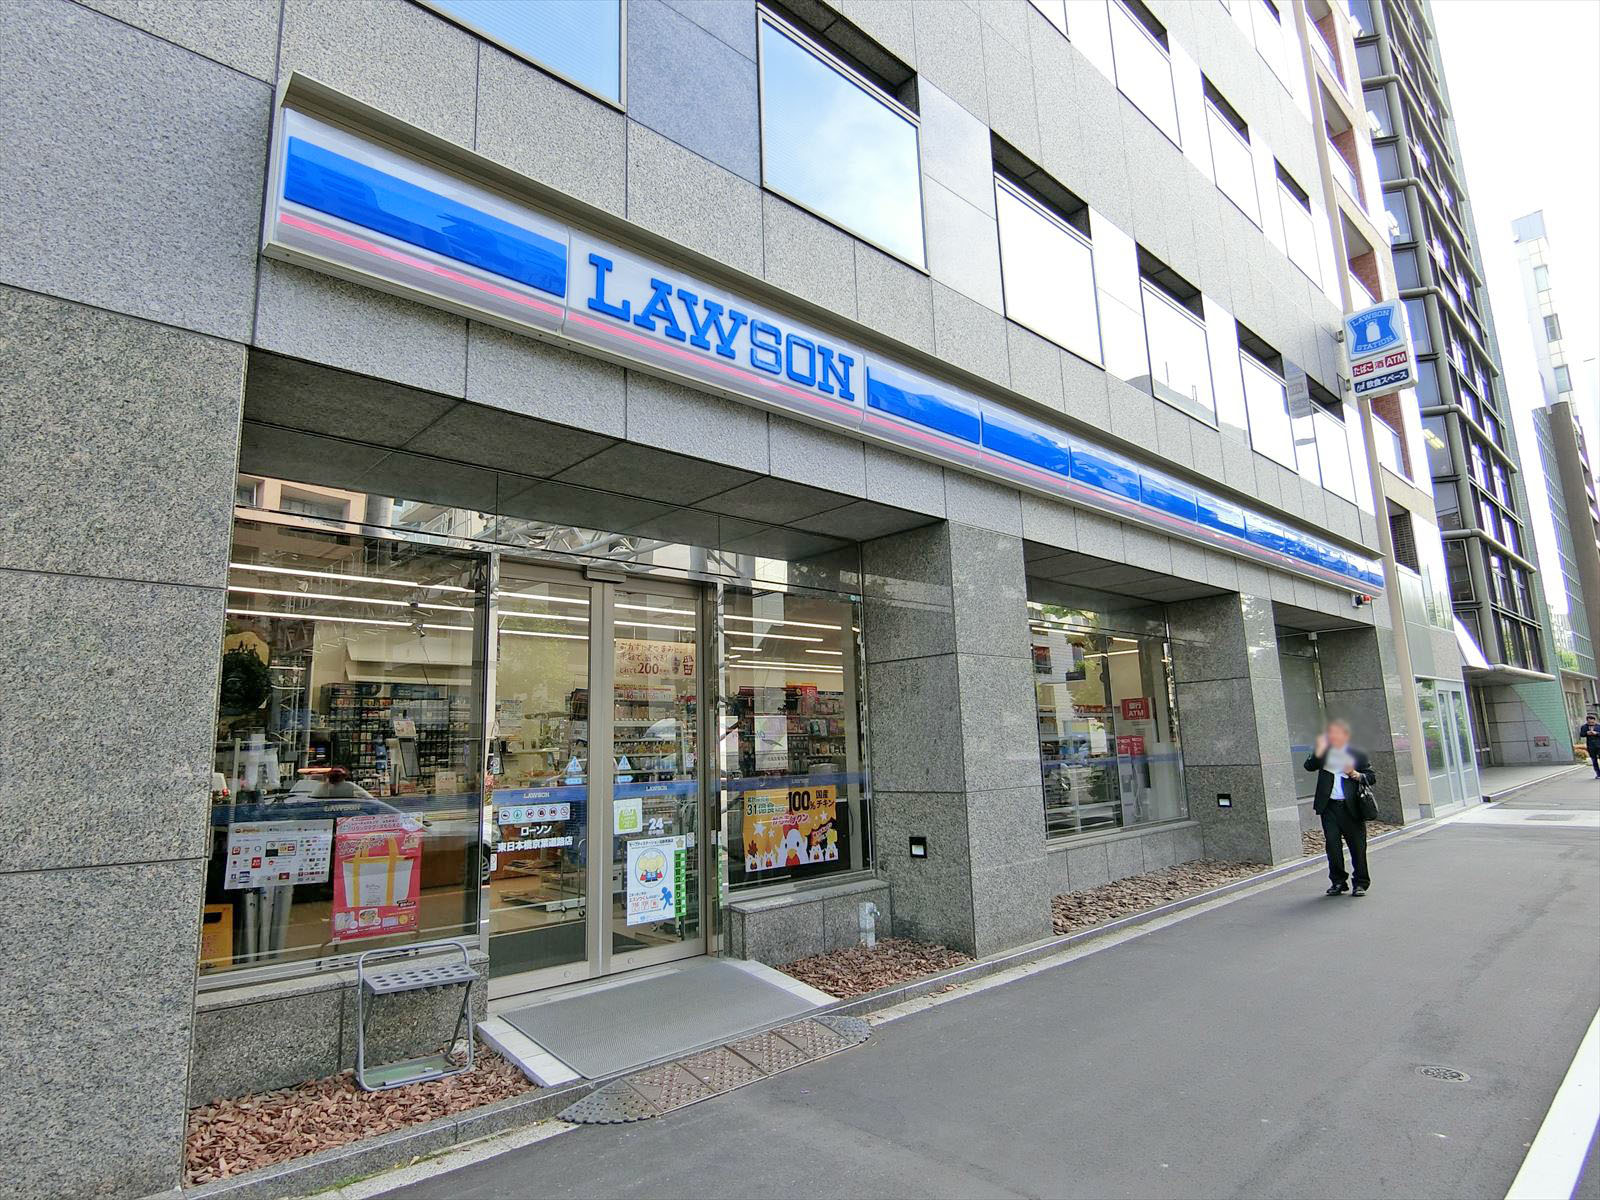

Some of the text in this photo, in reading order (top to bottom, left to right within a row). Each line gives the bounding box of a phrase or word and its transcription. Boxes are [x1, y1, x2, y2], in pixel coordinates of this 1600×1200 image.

[1351, 308, 1390, 327] LAWSON
[588, 253, 855, 402] LAWSON
[1356, 335, 1394, 351] STATION
[1353, 361, 1374, 376] たばこ
[1385, 353, 1407, 367] ATM
[637, 662, 659, 675] 200
[1128, 709, 1144, 717] ATM
[523, 791, 551, 799] LAWSON
[816, 799, 835, 809] チキン
[648, 817, 665, 831] 24
[520, 825, 553, 837] ローソン
